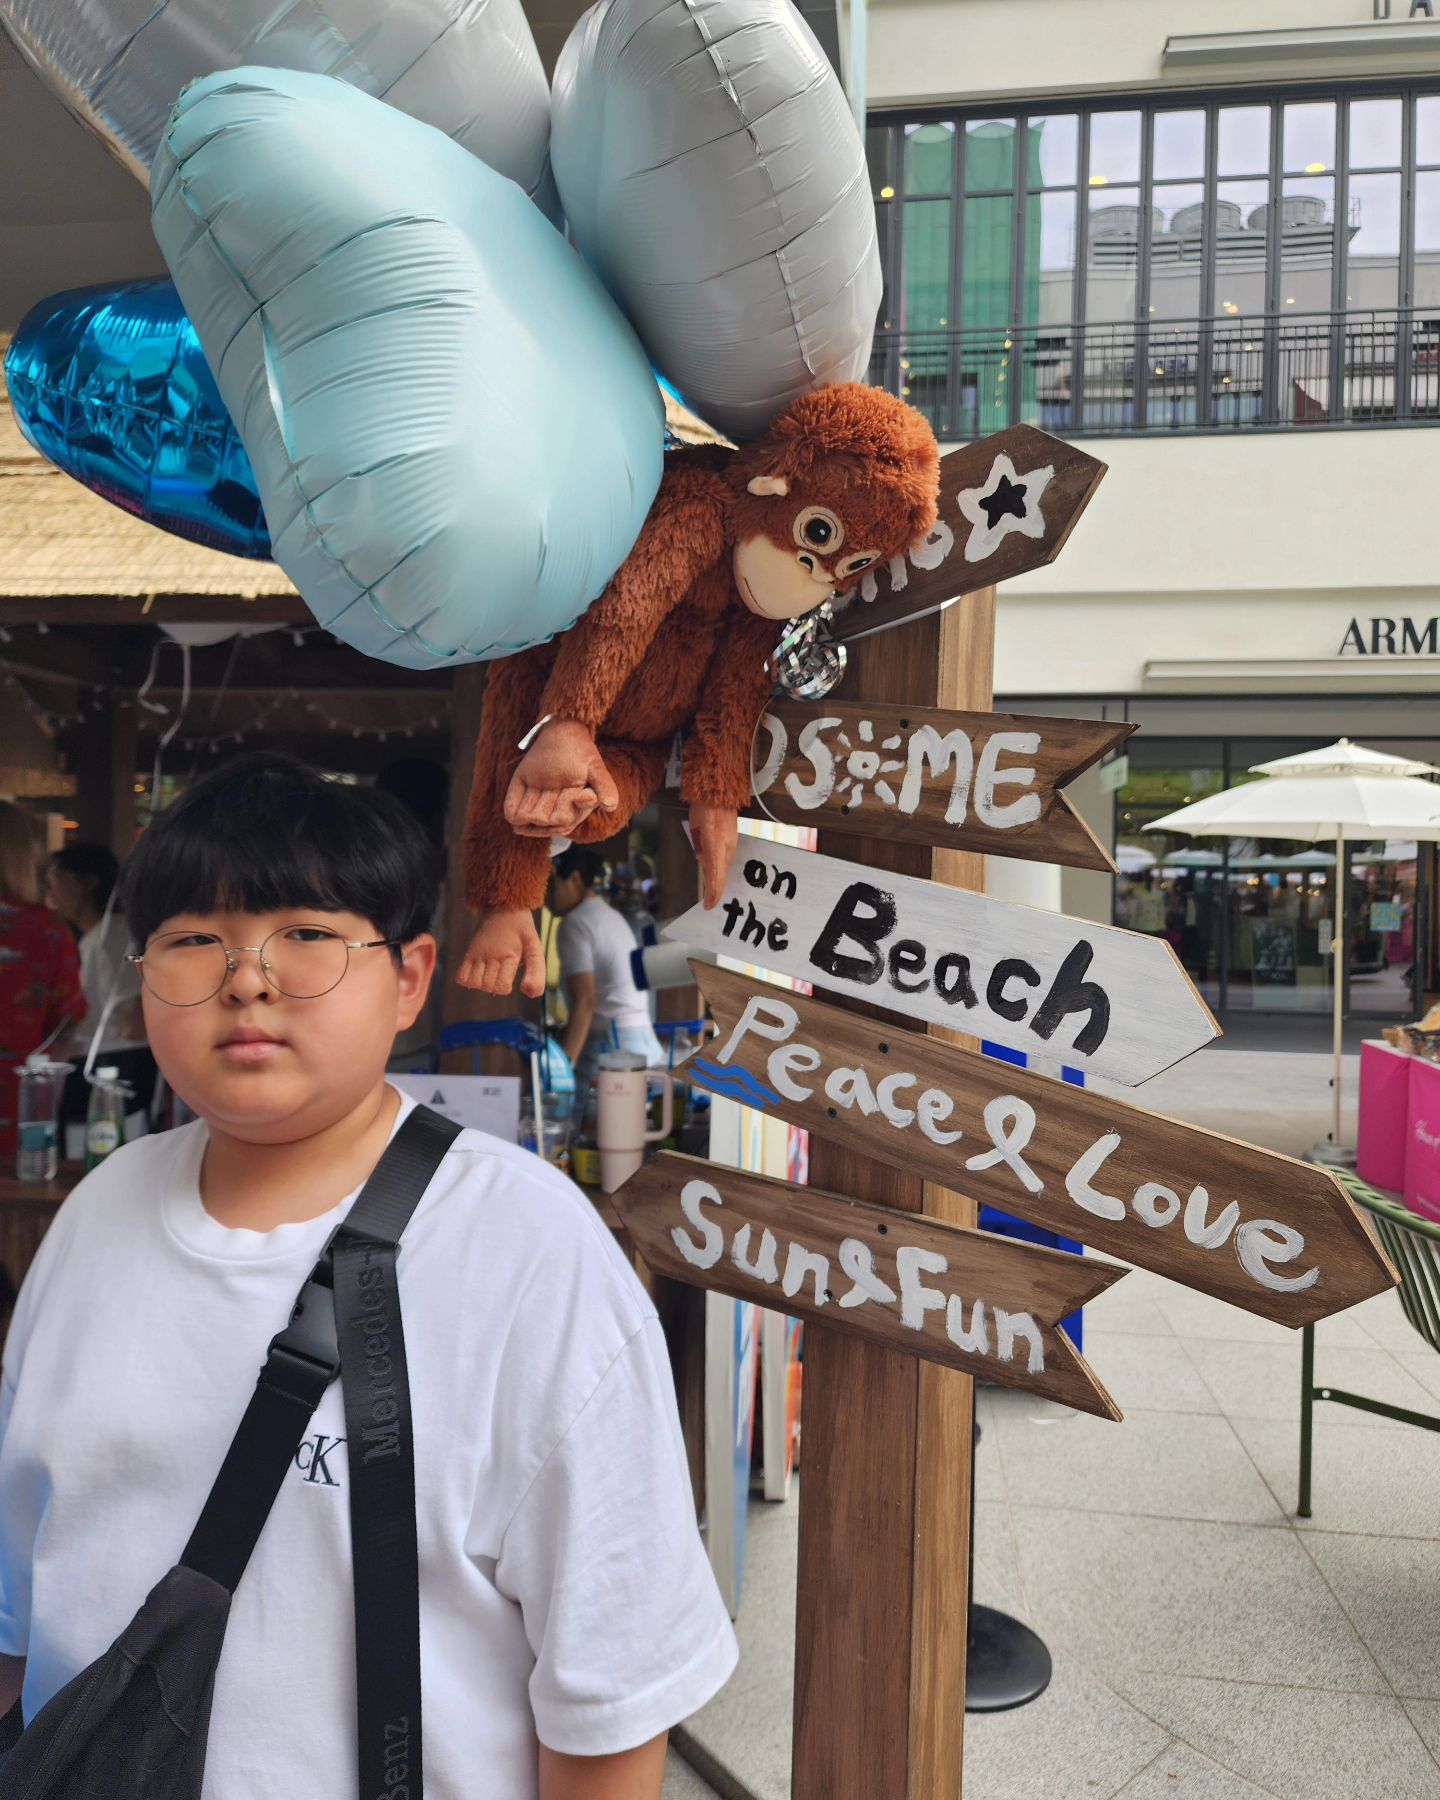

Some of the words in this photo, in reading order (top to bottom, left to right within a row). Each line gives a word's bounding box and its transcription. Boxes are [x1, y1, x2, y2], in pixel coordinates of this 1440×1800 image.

[722, 897, 789, 952] the
[809, 882, 1111, 1057] Beach
[715, 996, 963, 1145] Peace
[1065, 1131, 1320, 1292] Love
